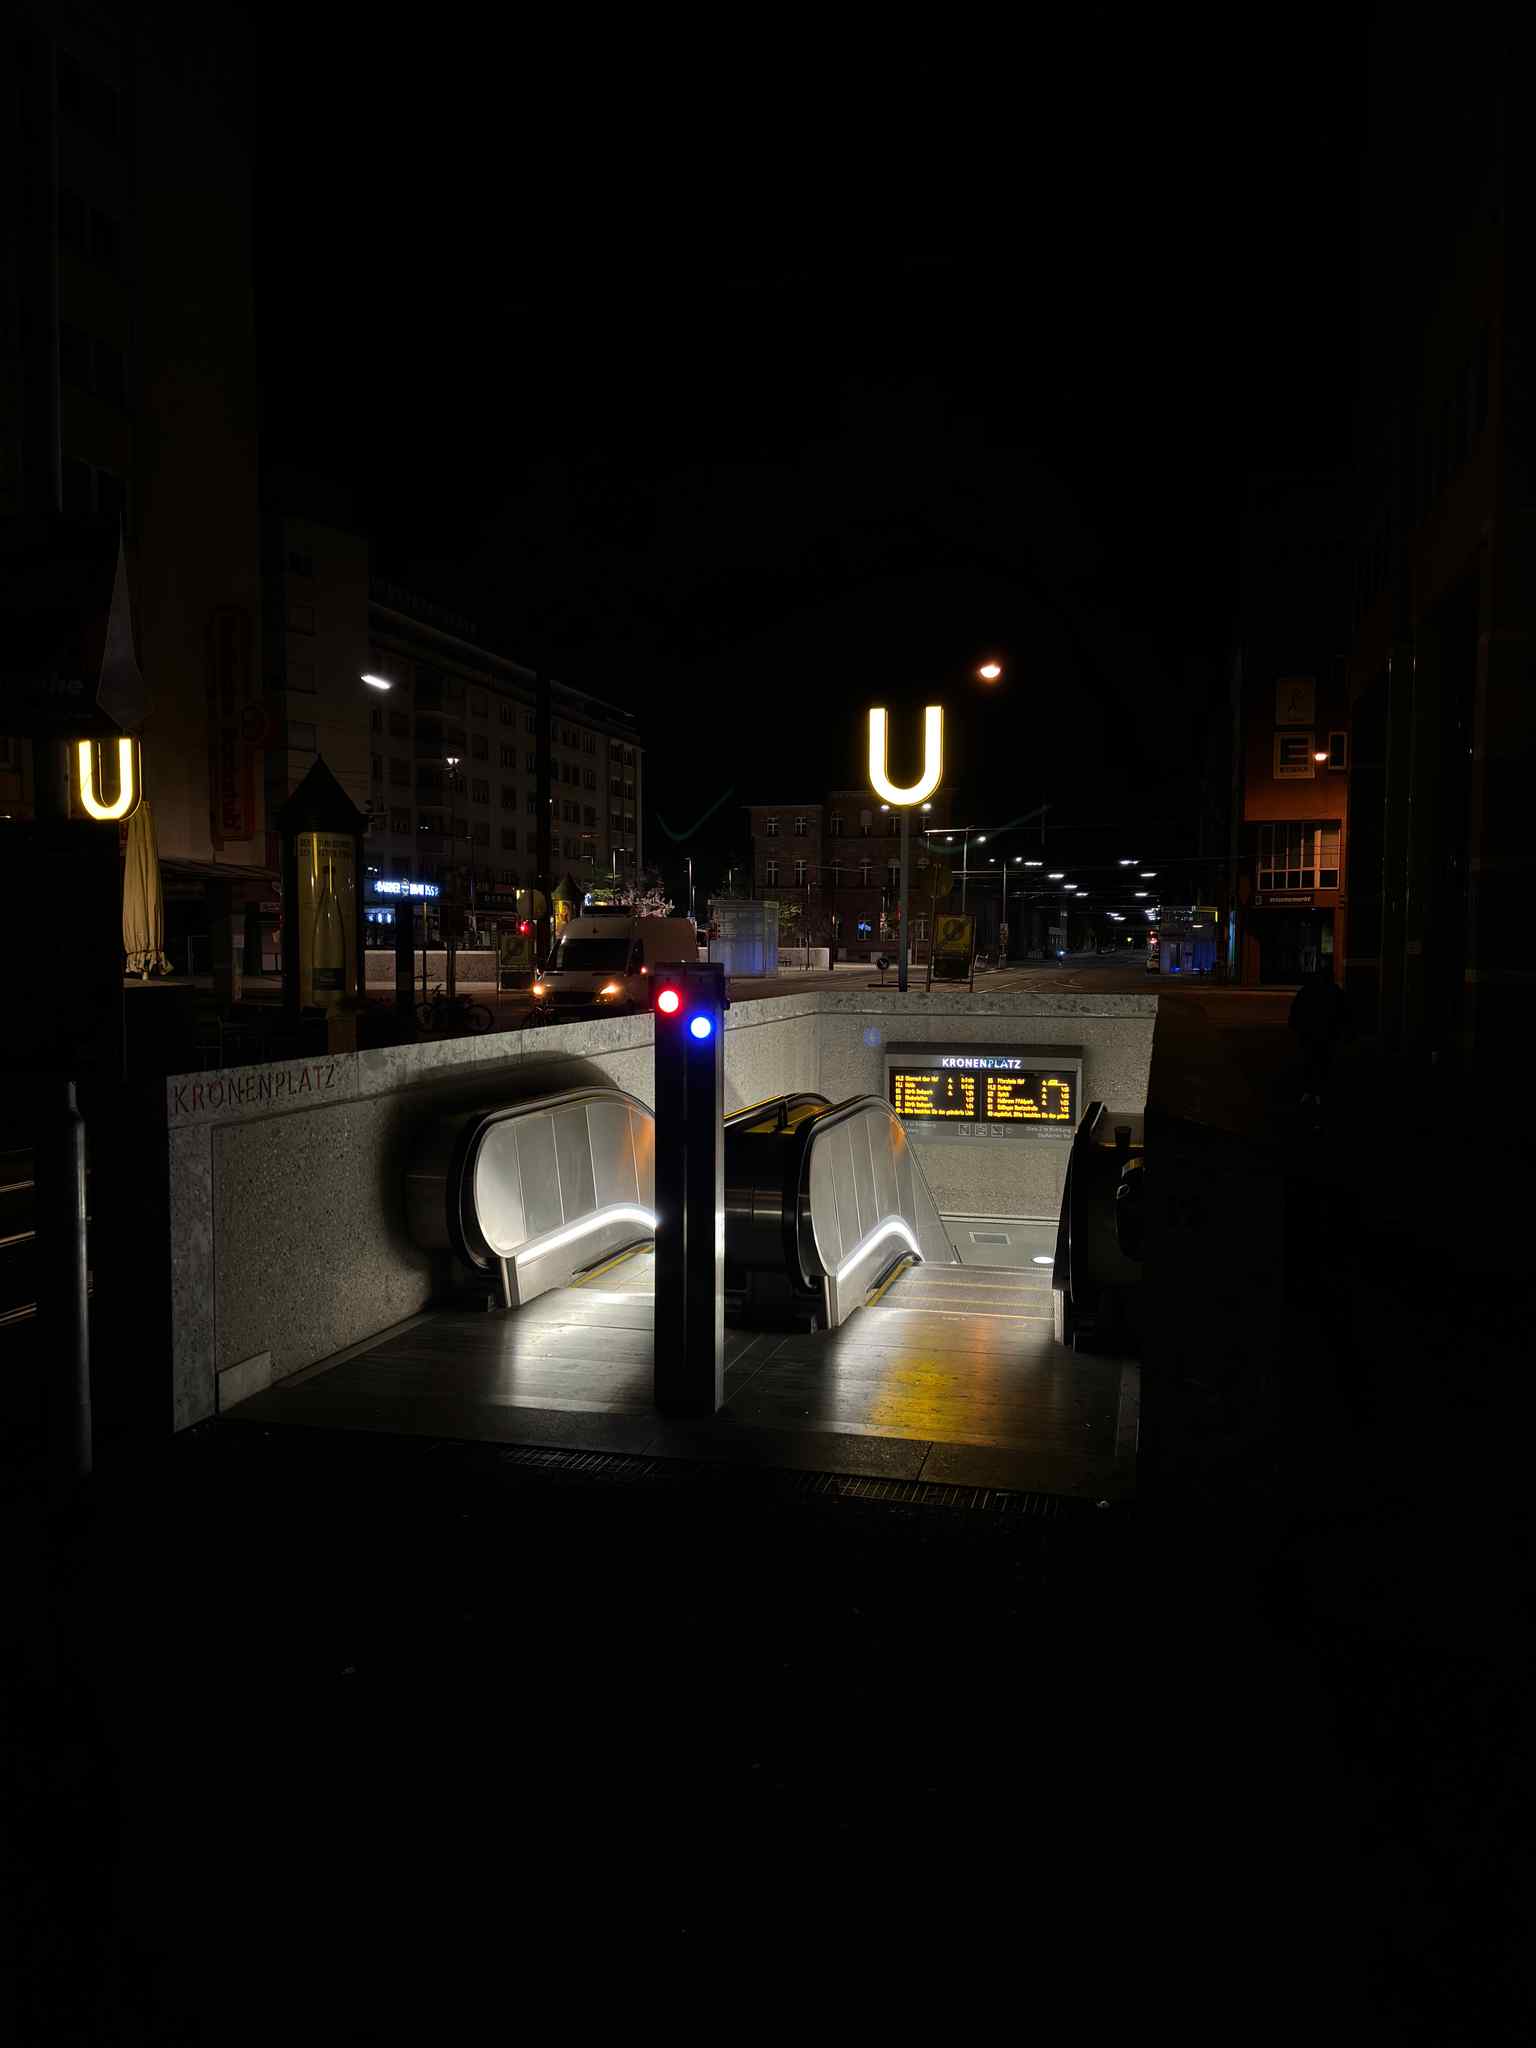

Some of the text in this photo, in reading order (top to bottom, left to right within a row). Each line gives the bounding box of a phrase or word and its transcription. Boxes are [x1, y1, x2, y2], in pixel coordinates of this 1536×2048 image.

[78, 737, 141, 821] U
[868, 705, 944, 806] U
[175, 1064, 335, 1114] KRONENPLATZ
[942, 1057, 1022, 1069] KRONENPLATZ
